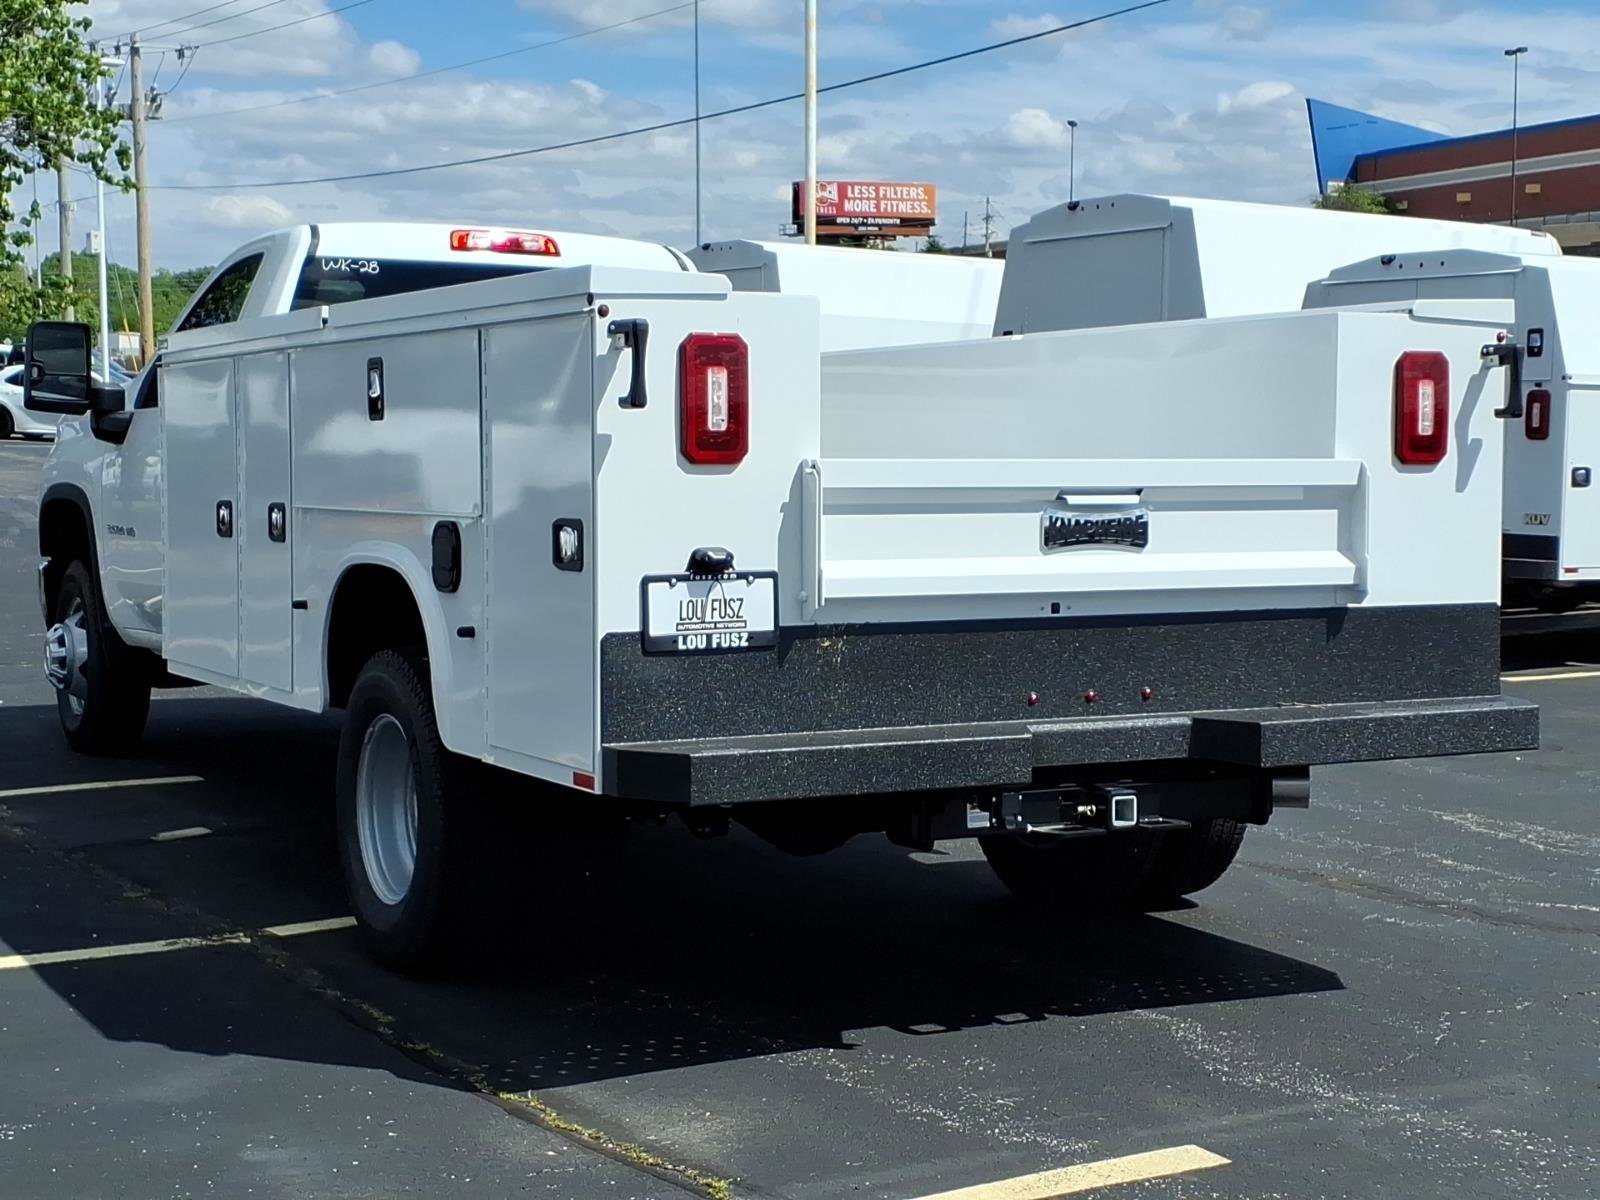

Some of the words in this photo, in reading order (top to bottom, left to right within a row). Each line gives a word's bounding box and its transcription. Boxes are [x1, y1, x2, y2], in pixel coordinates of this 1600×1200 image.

[847, 185, 876, 198] LESS
[879, 186, 928, 200] FILTERS.
[844, 199, 877, 213] MORE
[880, 200, 932, 214] FITNESS.
[321, 258, 380, 274] WK-28
[1523, 512, 1552, 526] KUV
[679, 598, 705, 621] LOU
[711, 597, 744, 620] FUSZ
[678, 634, 707, 650] LOU
[712, 632, 749, 648] FUSZ
